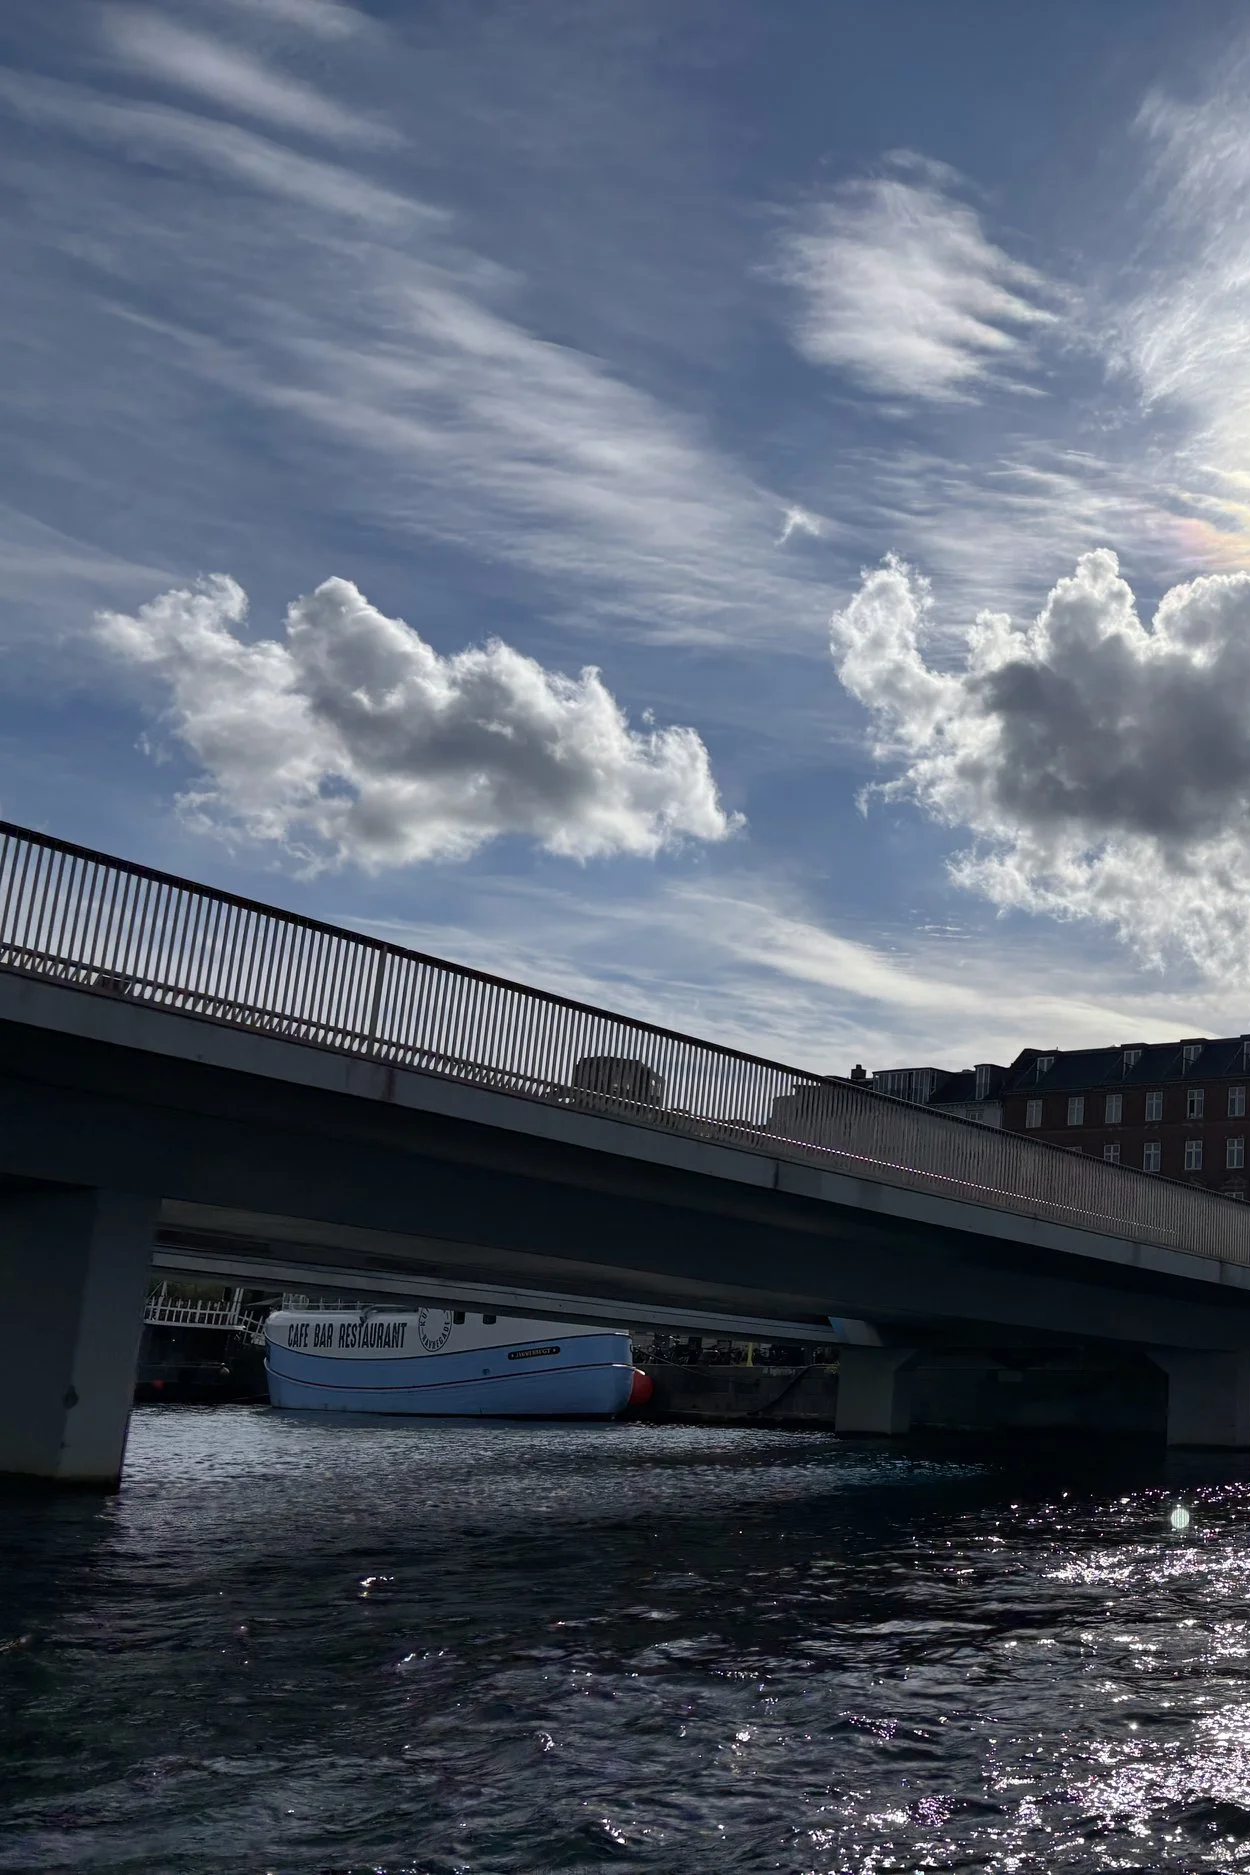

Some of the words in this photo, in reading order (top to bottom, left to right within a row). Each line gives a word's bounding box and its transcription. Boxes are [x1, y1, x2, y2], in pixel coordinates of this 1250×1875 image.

[287, 1323, 310, 1348] CAFE
[313, 1323, 334, 1348] BAR
[338, 1322, 408, 1349] RESTAURANT
